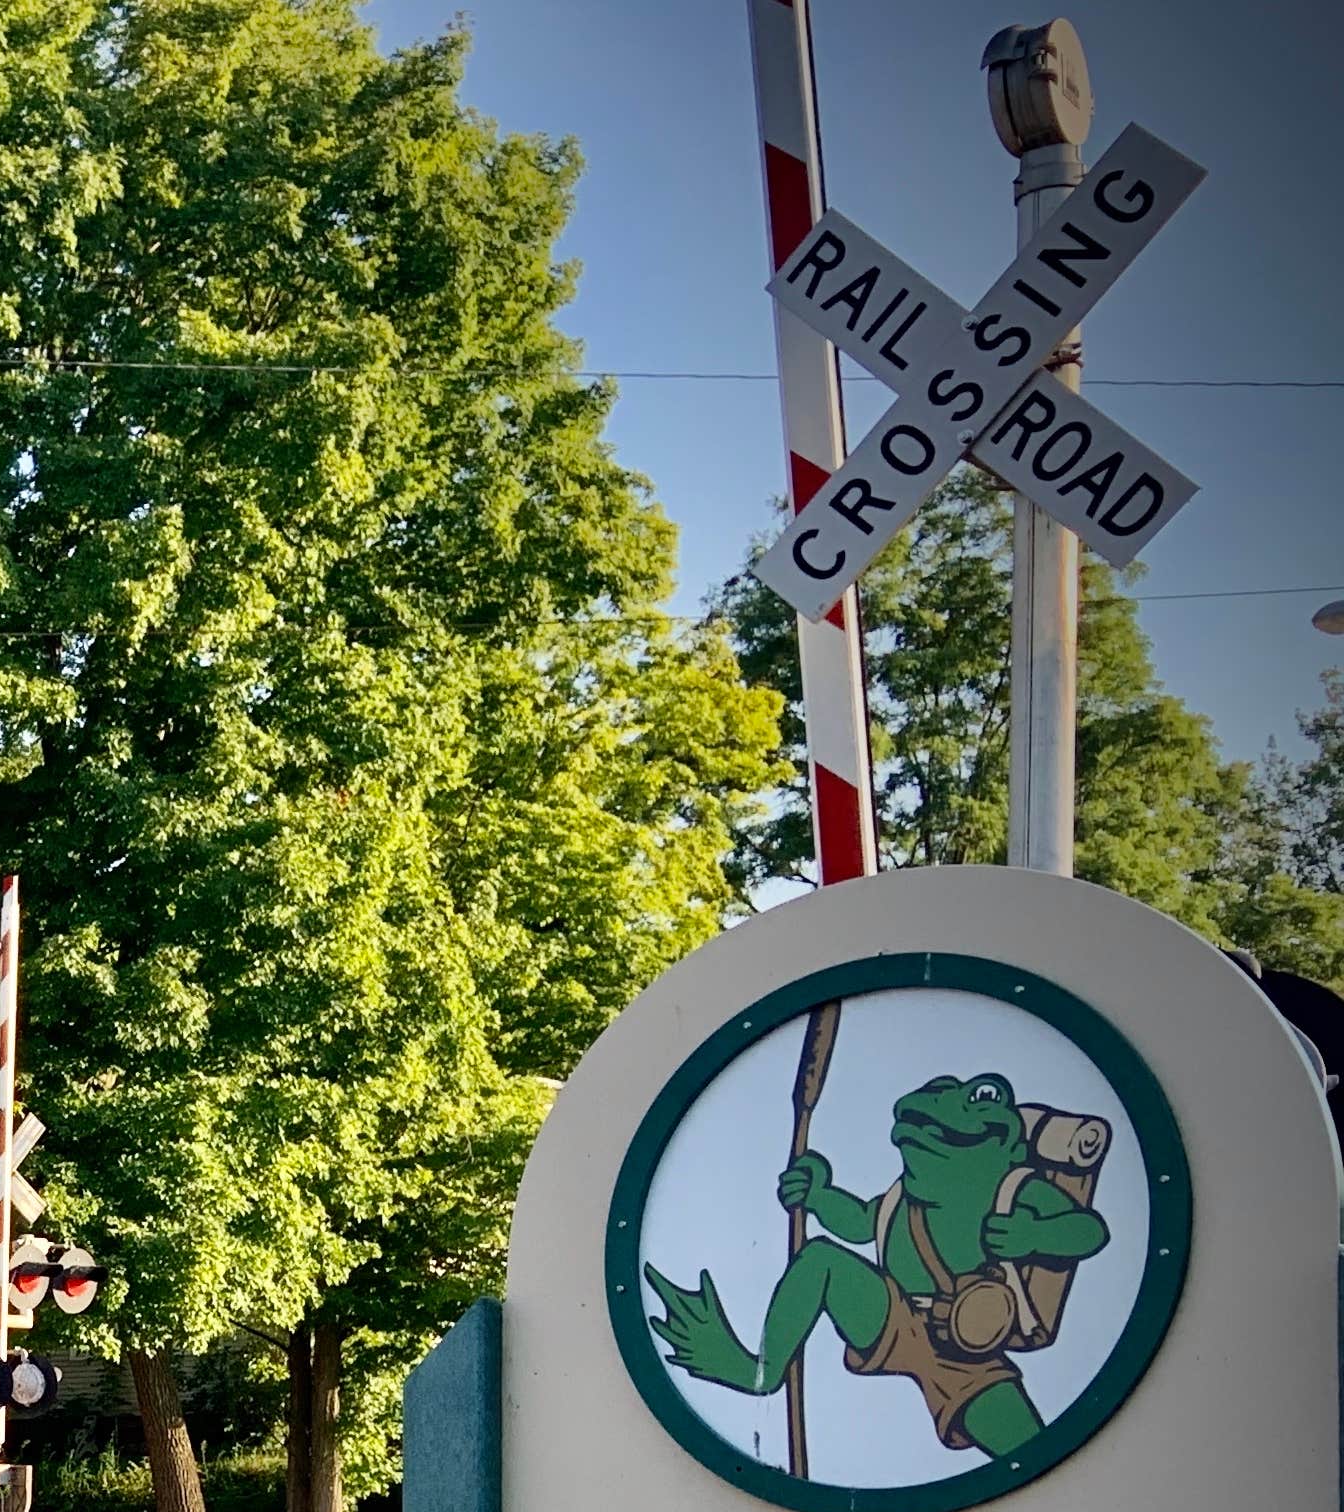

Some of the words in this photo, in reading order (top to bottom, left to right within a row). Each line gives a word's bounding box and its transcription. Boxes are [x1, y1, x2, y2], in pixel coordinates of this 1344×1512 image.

[786, 229, 928, 371] RAIL
[991, 389, 1165, 538] ROAD
[793, 168, 1155, 580] CROSSING
